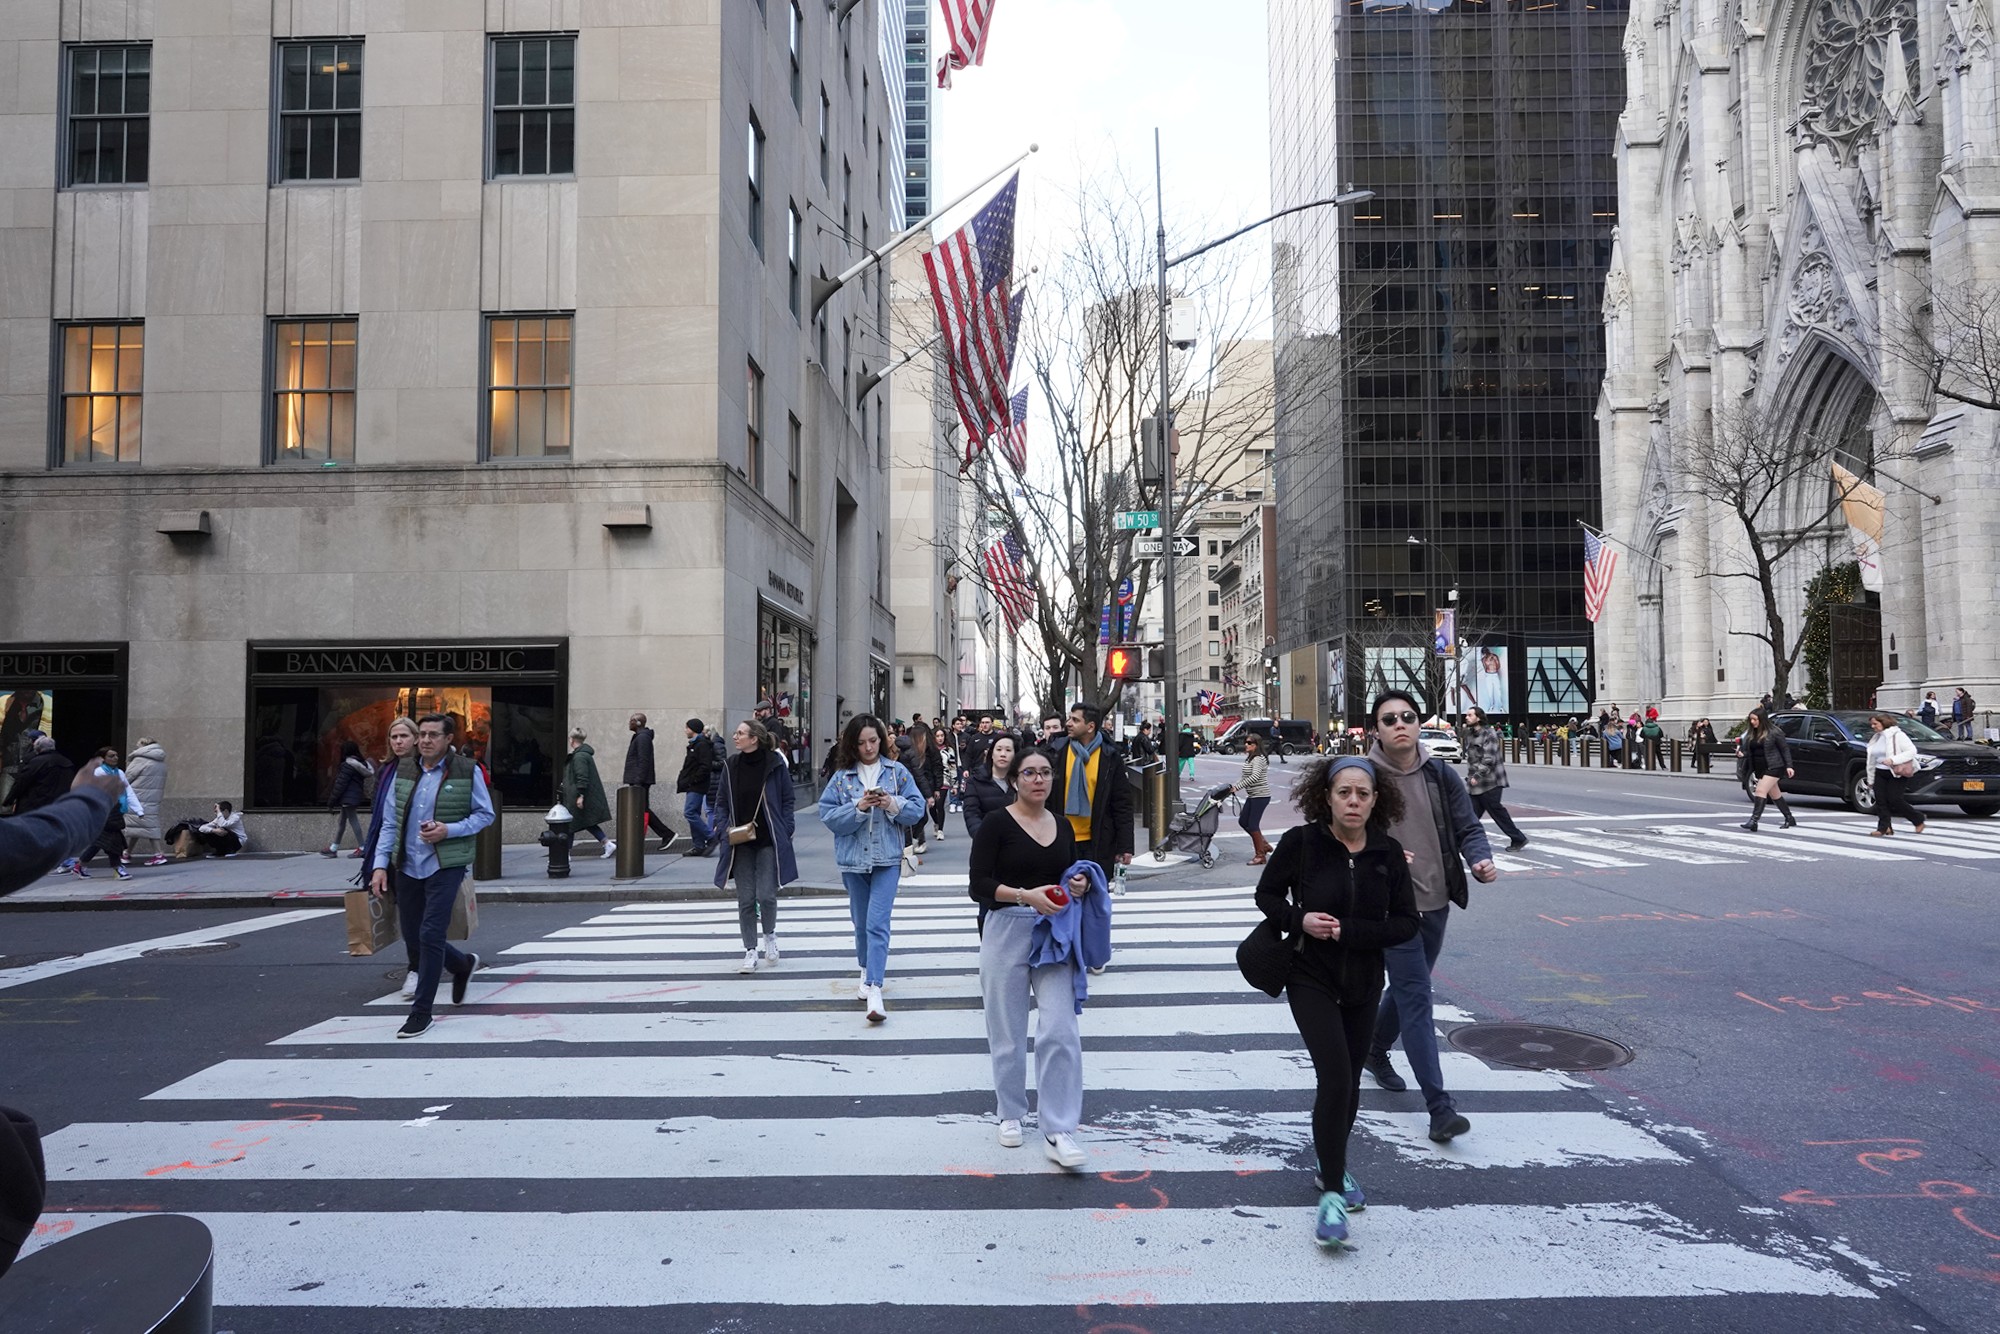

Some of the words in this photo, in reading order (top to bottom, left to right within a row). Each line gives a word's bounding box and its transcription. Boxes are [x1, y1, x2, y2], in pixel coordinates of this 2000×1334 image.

[1126, 514, 1134, 527] W
[1137, 513, 1149, 527] 50
[1151, 513, 1158, 522] St
[1143, 543, 1162, 551] ONE
[286, 652, 396, 673] BANANA
[403, 650, 526, 672] REPUBLIC
